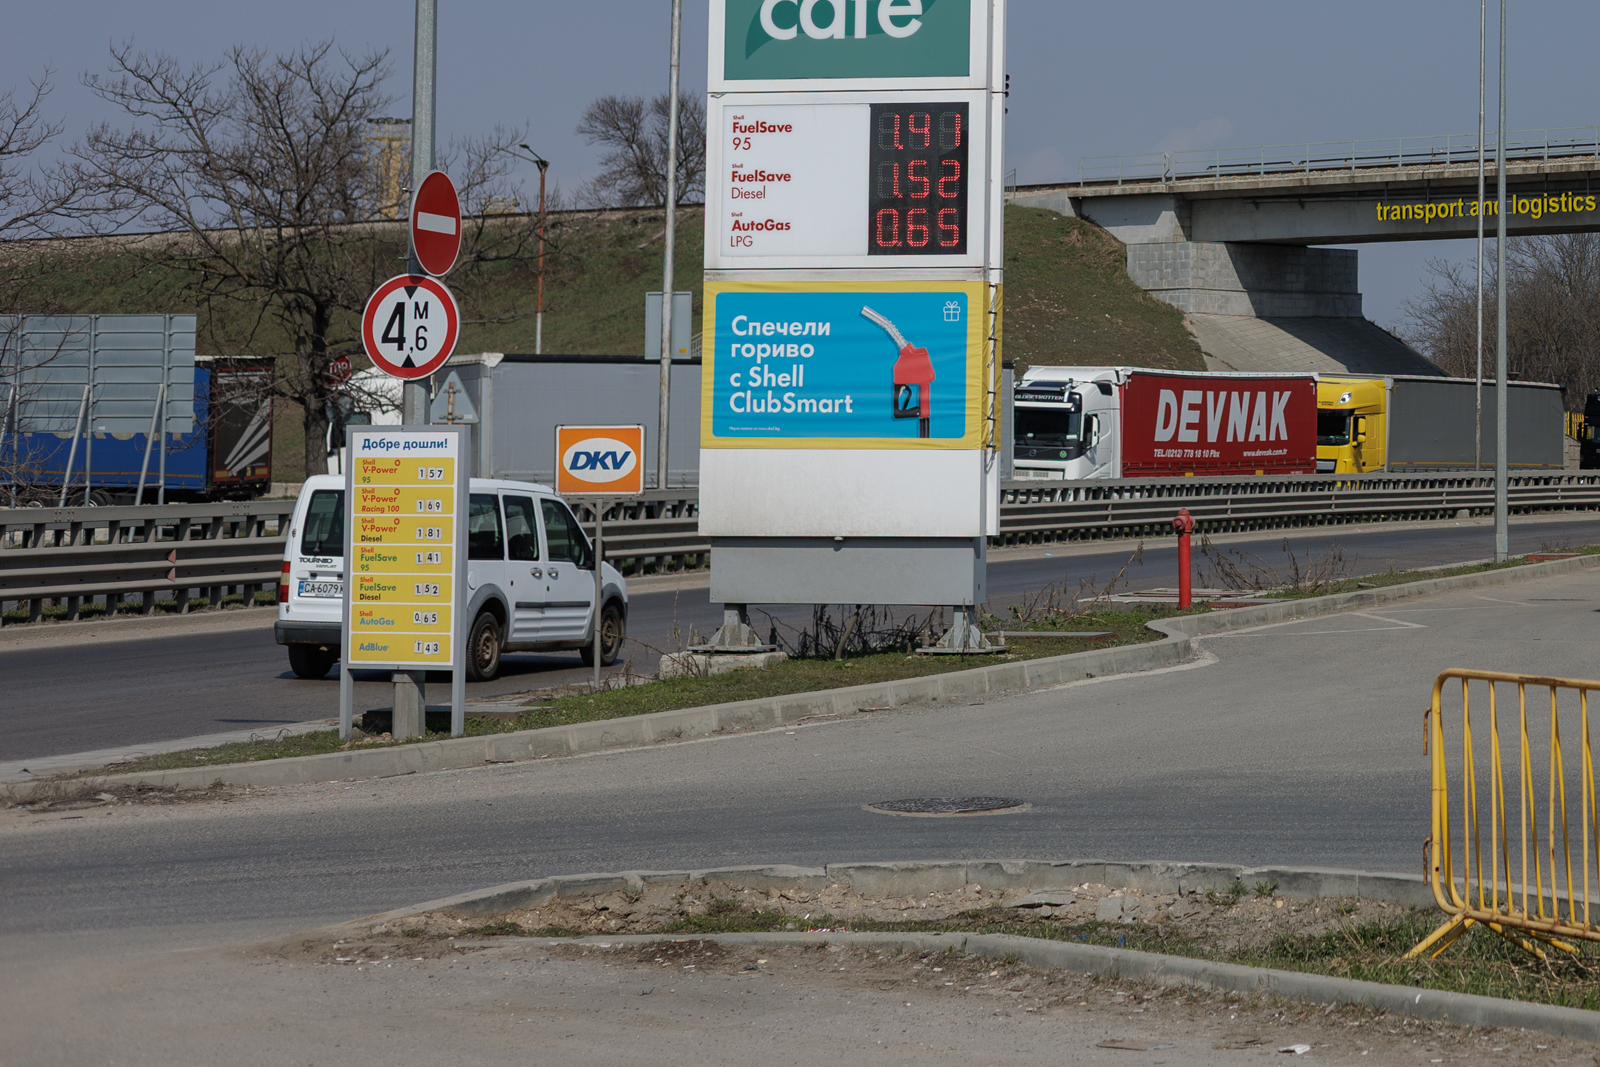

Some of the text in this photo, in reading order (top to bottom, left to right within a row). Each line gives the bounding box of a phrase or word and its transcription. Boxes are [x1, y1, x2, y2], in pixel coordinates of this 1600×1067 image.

[733, 121, 793, 133] FuelSave
[733, 137, 751, 150] 95
[732, 170, 791, 182] FuelSave
[893, 160, 960, 198] 1.52
[731, 185, 766, 199] Diesel
[1376, 198, 1465, 224] transport
[1512, 192, 1597, 219] logistics
[731, 219, 791, 231] AutoGas
[876, 208, 959, 247] 0.65
[730, 235, 753, 247] LPG
[381, 301, 406, 352] 4
[731, 315, 831, 336] Спечели
[730, 341, 814, 364] гориво
[748, 364, 804, 388] Shell
[729, 391, 853, 414] ClubSmart
[1154, 389, 1292, 443] DEVNAK
[362, 438, 448, 451] Добре дошли!
[569, 451, 632, 470] DKV
[362, 466, 398, 474] V-Power
[361, 505, 385, 514] Racing
[360, 553, 397, 562] FuelSave
[359, 583, 396, 591] FuelSave
[359, 617, 395, 625] AutoGas
[359, 643, 388, 651] AdBlue
